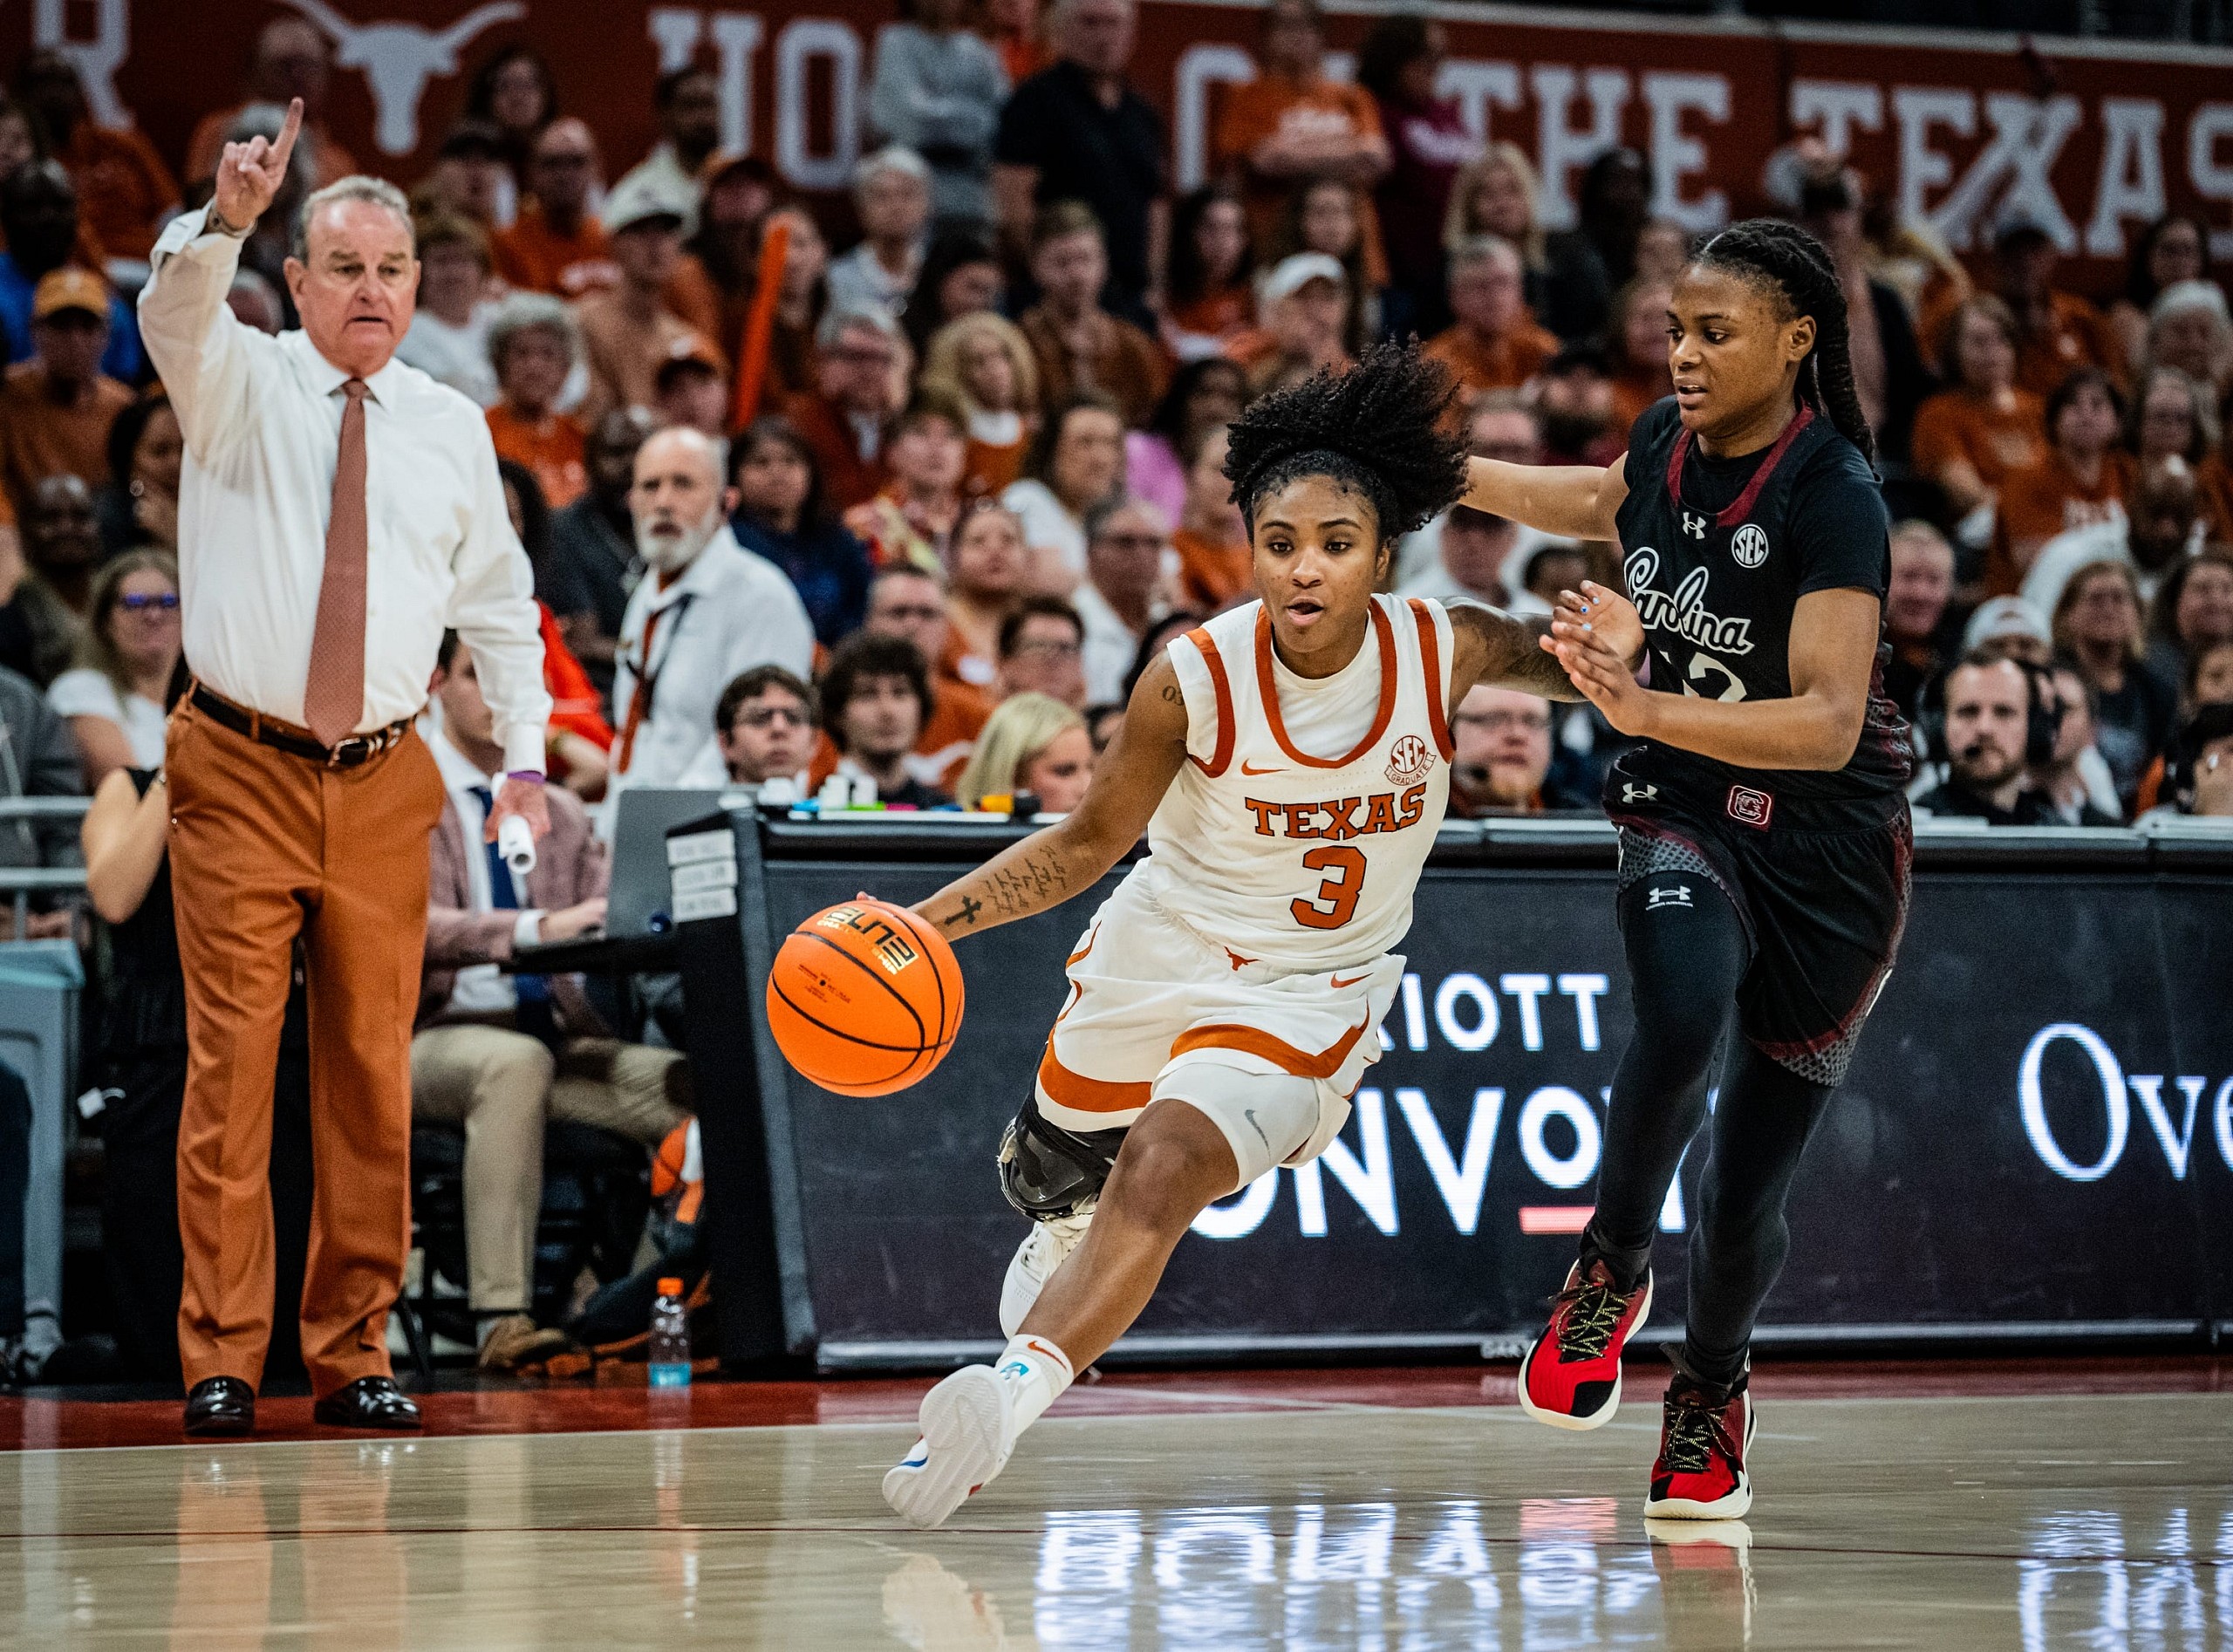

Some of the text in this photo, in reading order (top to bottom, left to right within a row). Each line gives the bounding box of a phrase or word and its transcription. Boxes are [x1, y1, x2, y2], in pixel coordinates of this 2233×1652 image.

[649, 10, 862, 187] HO
[1434, 58, 1731, 234] THE
[1734, 526, 1766, 566] SEC
[1624, 546, 1755, 655] Carolina
[1390, 763, 1430, 785] GRADUATE
[1391, 735, 1425, 774] SEC
[1245, 782, 1427, 841] TEXAS
[1289, 844, 1368, 930] 3
[1377, 973, 1608, 1051] IOTT
